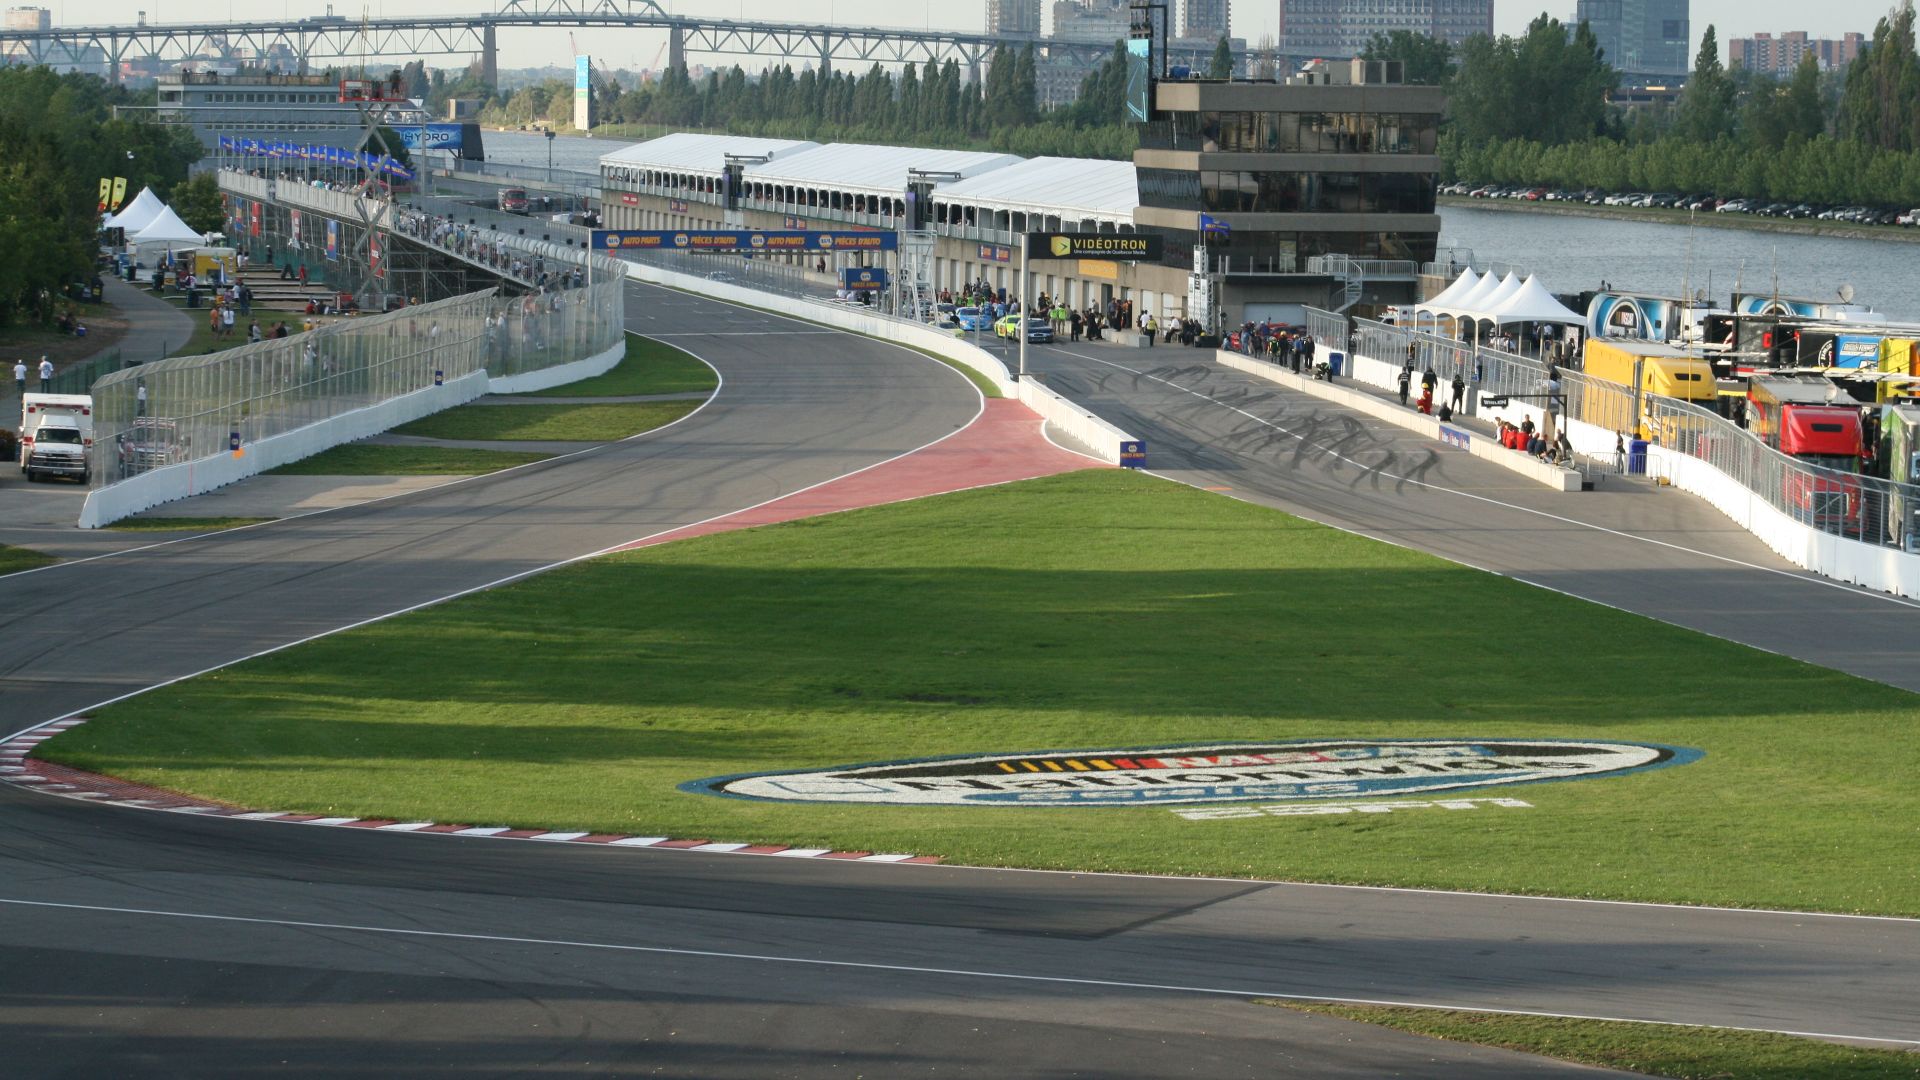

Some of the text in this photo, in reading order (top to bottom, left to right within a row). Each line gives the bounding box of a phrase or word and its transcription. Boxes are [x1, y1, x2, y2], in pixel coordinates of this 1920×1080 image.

[622, 236, 640, 245] AUTO
[767, 237, 785, 245] AUTO
[1074, 237, 1146, 249] VIDÉOTRON
